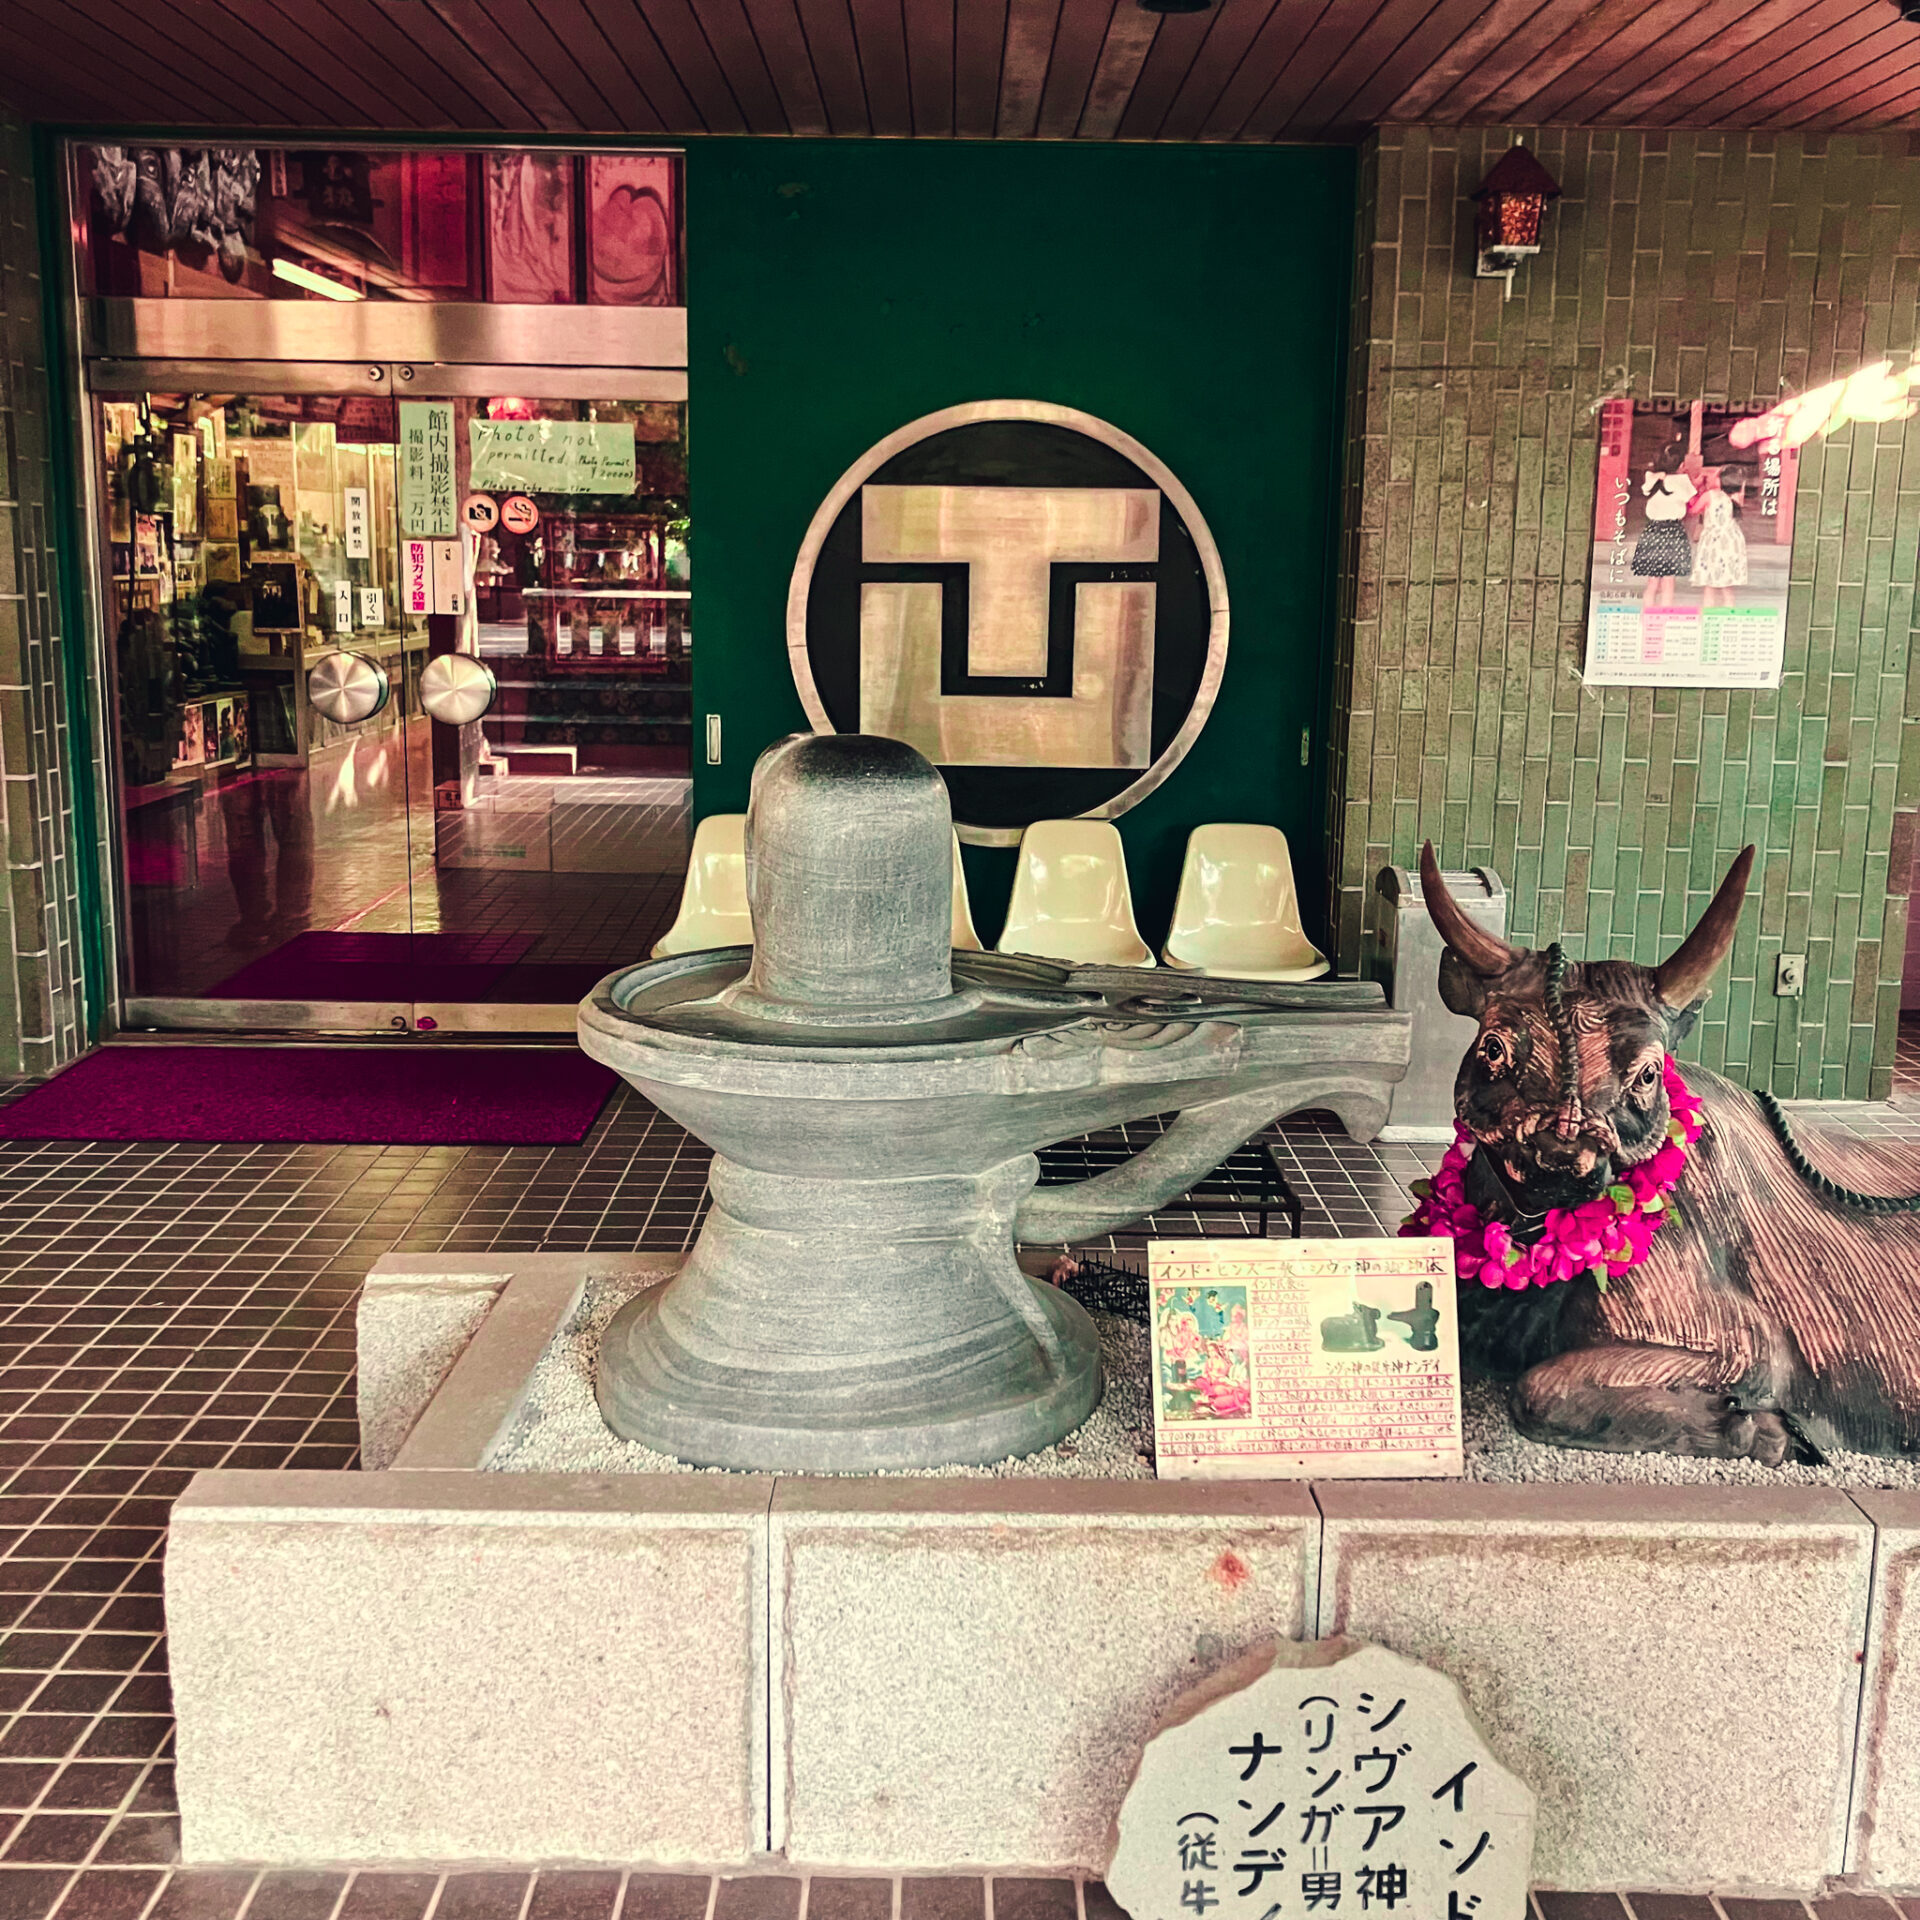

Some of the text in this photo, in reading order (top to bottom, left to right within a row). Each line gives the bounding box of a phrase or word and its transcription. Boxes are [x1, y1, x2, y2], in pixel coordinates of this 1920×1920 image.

[409, 428, 425, 532] 撮影料二万円
[428, 409, 450, 534] 館内撮影禁止
[562, 433, 595, 447] not
[1609, 476, 1632, 584] いつもそばに
[366, 593, 377, 614] 引く
[410, 543, 425, 611] 防犯カメラ設置
